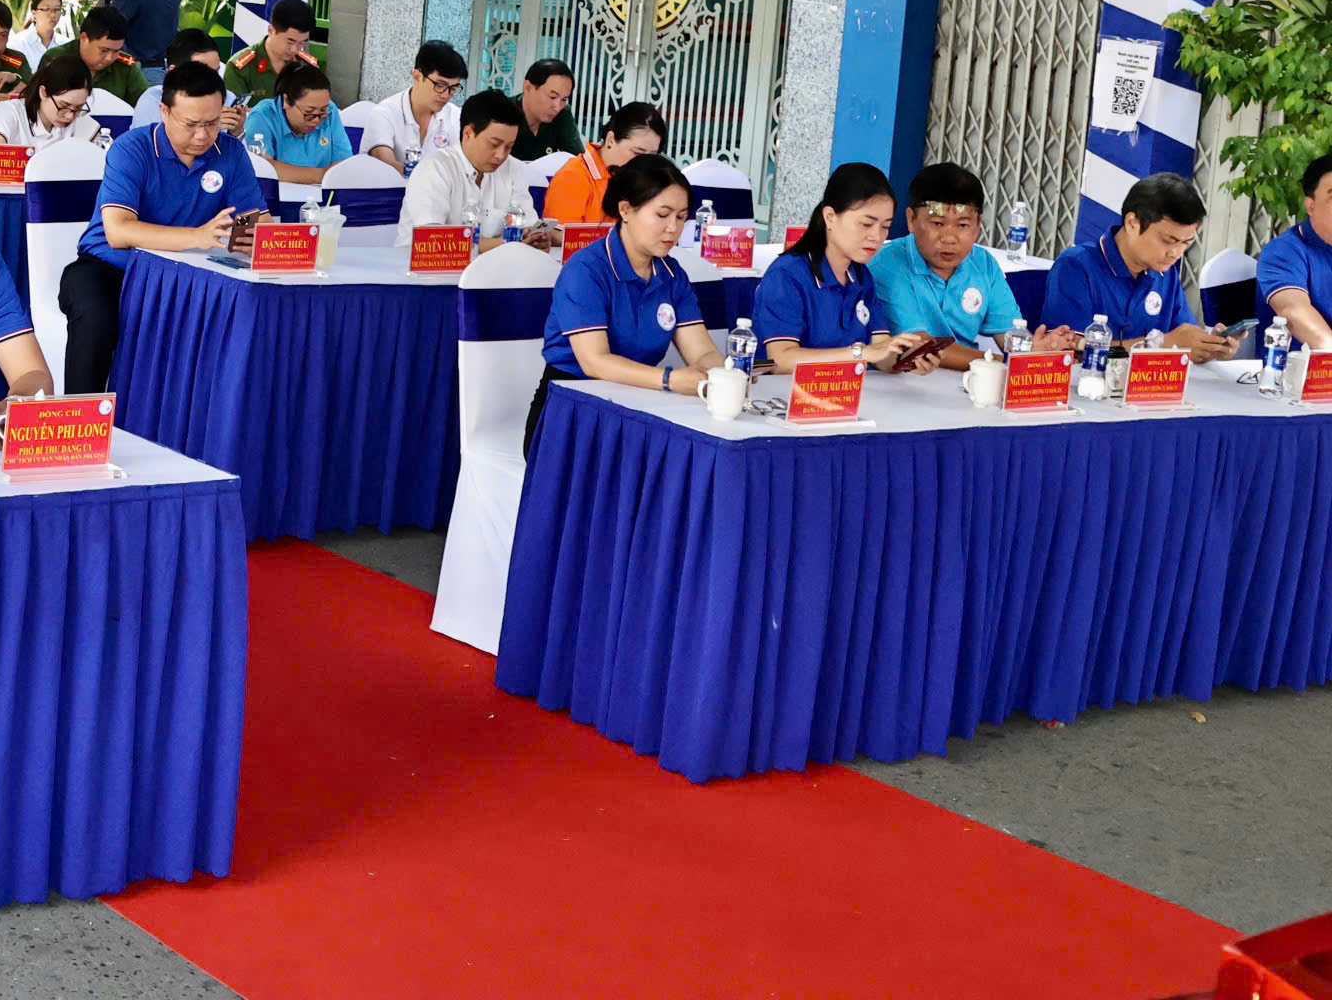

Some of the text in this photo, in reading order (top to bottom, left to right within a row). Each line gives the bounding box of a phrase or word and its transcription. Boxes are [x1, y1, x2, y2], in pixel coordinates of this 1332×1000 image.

[10, 422, 108, 441] NGUYỄN PHI LONG
